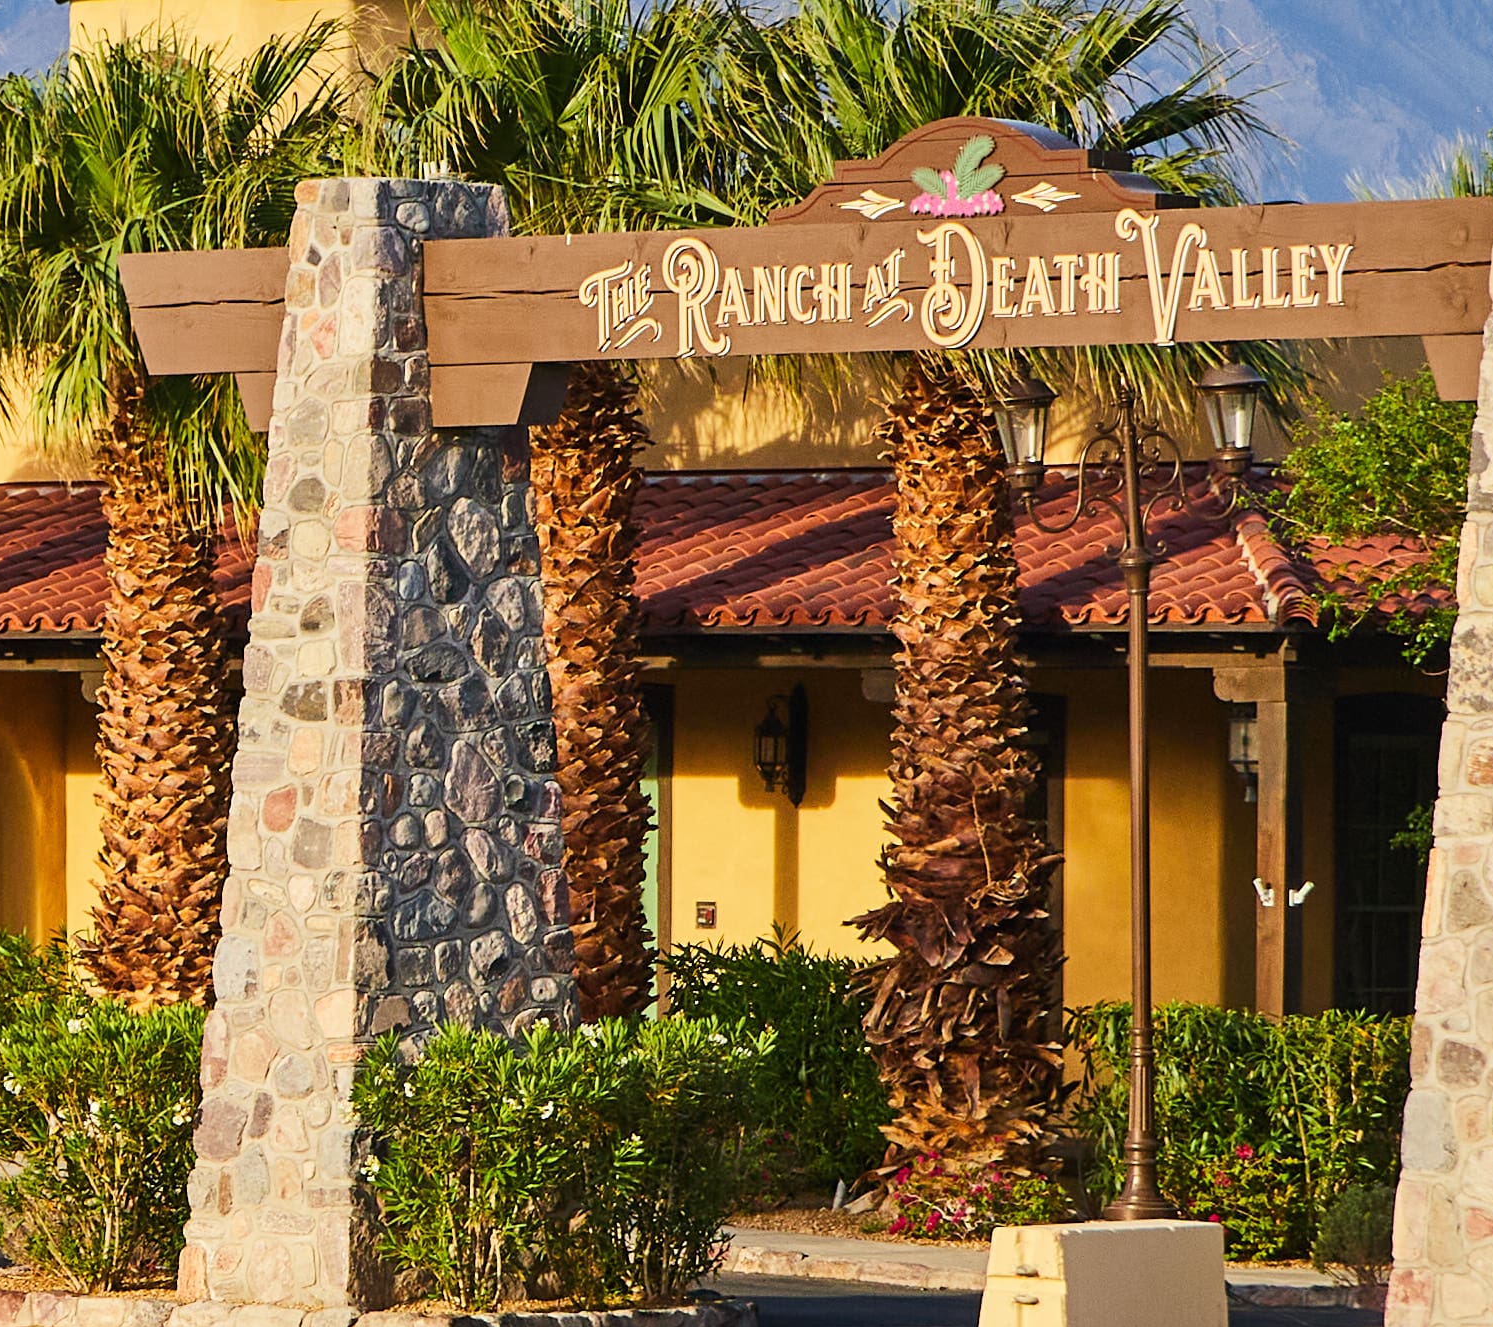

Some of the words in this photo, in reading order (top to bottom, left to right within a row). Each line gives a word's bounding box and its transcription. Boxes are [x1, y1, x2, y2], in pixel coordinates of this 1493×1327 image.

[662, 237, 854, 359] RANCH
[916, 221, 1121, 349] DEATH
[1114, 207, 1354, 347] VALLEY
